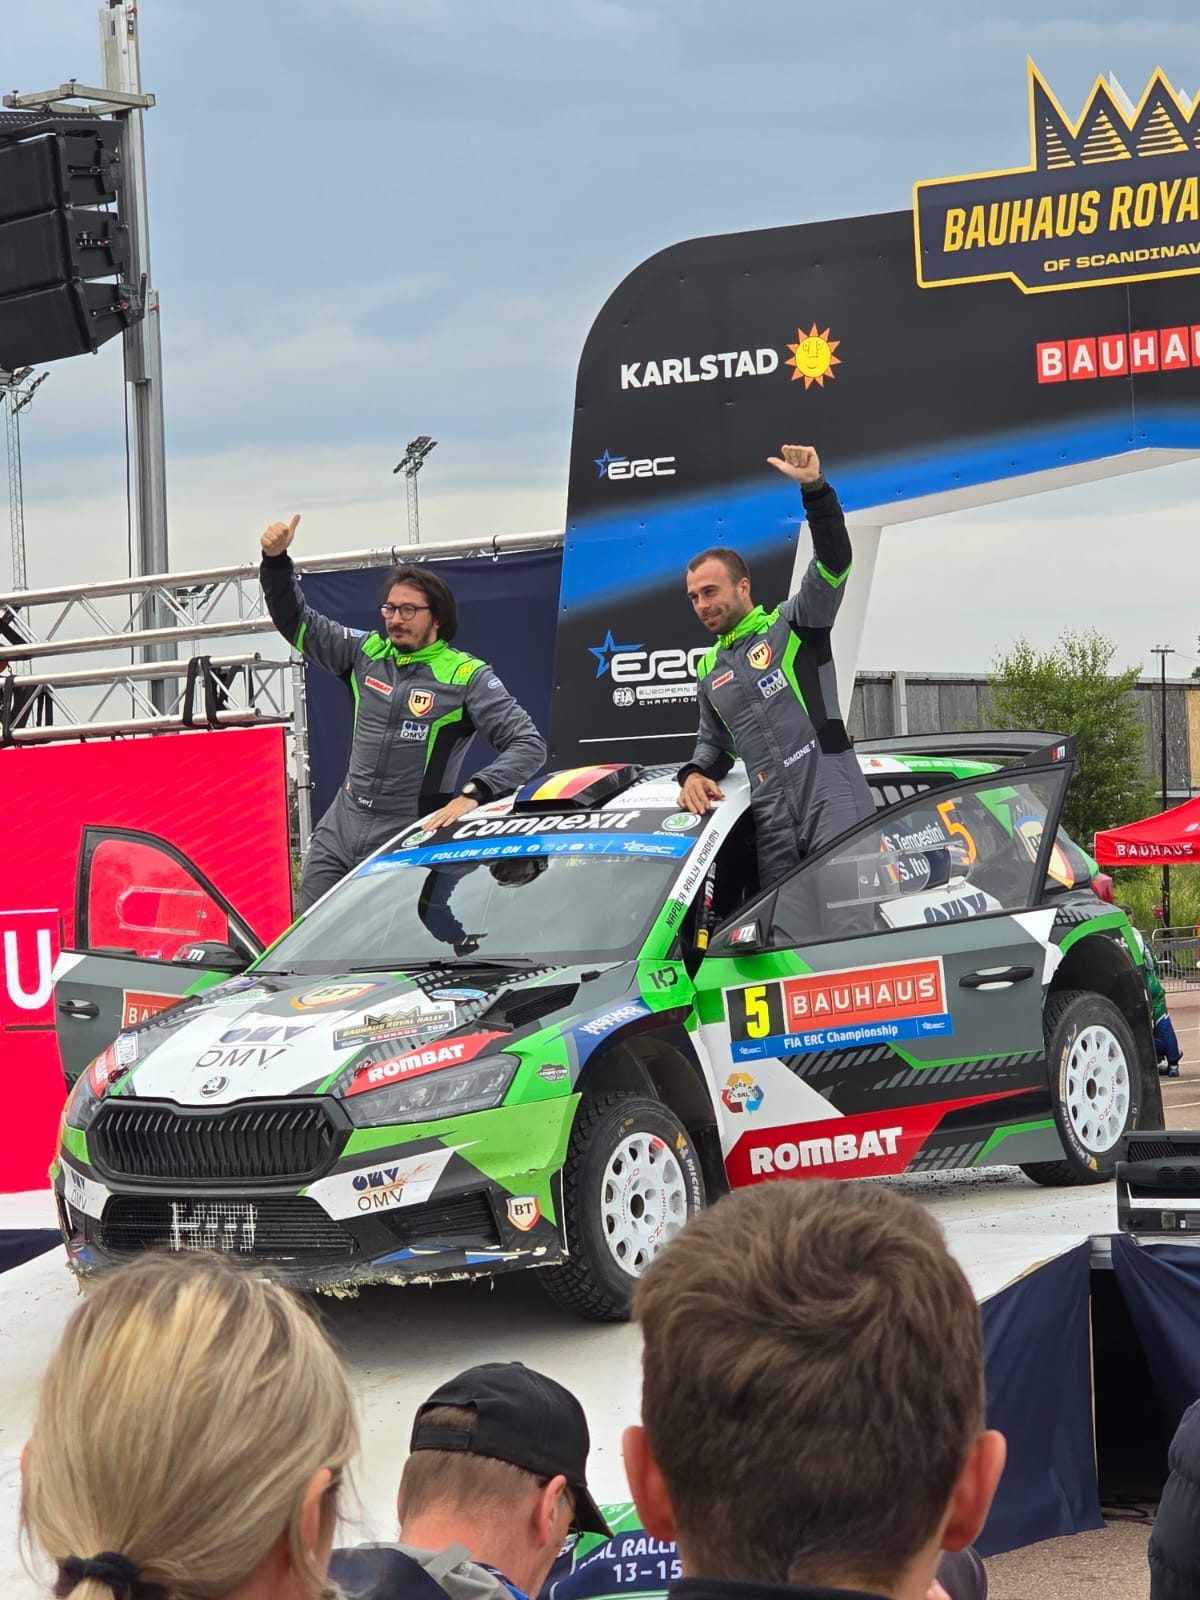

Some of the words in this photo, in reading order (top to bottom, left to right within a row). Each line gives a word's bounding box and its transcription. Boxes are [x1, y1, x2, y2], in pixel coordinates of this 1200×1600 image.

[944, 190, 1101, 252] BAUHAUS
[1043, 258, 1070, 272] OF
[1041, 330, 1200, 377] BAUHA
[620, 348, 779, 389] KARLSTAD
[607, 456, 676, 480] ERC
[753, 646, 766, 661] BT
[765, 681, 784, 696] OMV
[414, 695, 430, 706] BT
[402, 731, 426, 740] OMV
[783, 744, 811, 768] SIMONE
[937, 801, 977, 865] 5
[430, 848, 479, 861] FOLLOW
[481, 846, 500, 857] US
[501, 845, 522, 855] ON
[1117, 843, 1194, 856] BAUHAUS
[685, 865, 701, 894] RALLY
[696, 829, 720, 867] ACADEMY
[744, 986, 771, 1038] 5
[793, 977, 936, 1015] BAUHAUS
[386, 1018, 415, 1030] ROYAL
[416, 1013, 445, 1024] RALLY
[426, 1022, 450, 1032] 2024
[784, 1038, 802, 1050] FIA
[804, 1035, 825, 1047] ERC
[827, 1025, 898, 1044] Championship
[195, 1048, 288, 1068] OMV
[367, 1044, 464, 1083] ROMBAT
[749, 1126, 903, 1175] ROMBAT
[357, 1188, 404, 1211] OMV
[514, 1202, 533, 1216] BT
